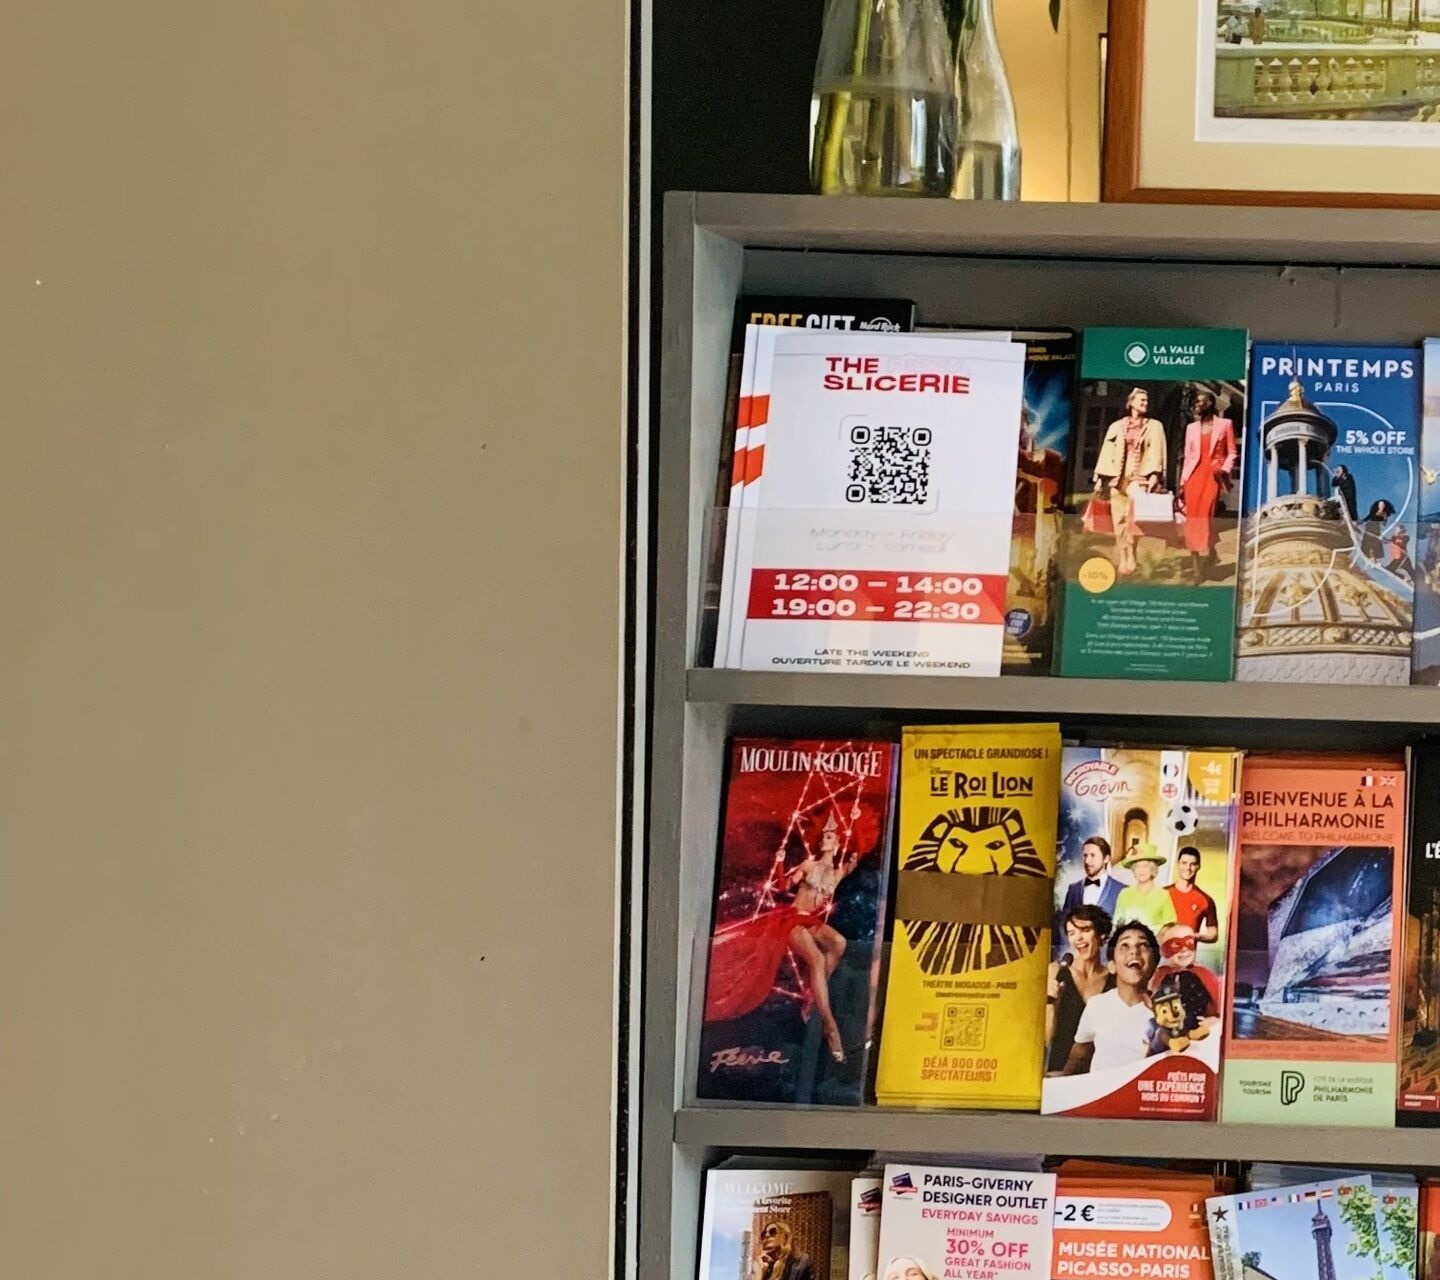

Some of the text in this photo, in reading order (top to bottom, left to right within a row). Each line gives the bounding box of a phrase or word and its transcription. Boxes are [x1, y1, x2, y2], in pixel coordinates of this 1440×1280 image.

[1152, 344, 1205, 355] LA VALLÉE
[825, 357, 880, 374] THE
[1152, 355, 1196, 365] VILLAGE
[1261, 356, 1415, 379] PRINTEMPS
[823, 373, 970, 394] SLICERIE
[1314, 381, 1360, 393] PARIS
[1345, 429, 1406, 446] 5% OFF
[1336, 445, 1415, 456] THE WHOLE STORE
[774, 573, 859, 592] 12:00
[895, 576, 983, 596] 14:00
[771, 598, 857, 617] 19:00
[893, 600, 981, 620] 22:30
[740, 747, 883, 778] MOULIN ROUGE
[930, 774, 949, 793] LE
[1243, 788, 1394, 808] BIENVENUE À LA
[1242, 811, 1385, 829] PHILHARMONIE
[922, 1191, 1048, 1210] DESIGNER OUTLET
[921, 1208, 1039, 1225] EVERYDAY SAVINGS
[946, 1228, 995, 1239] MINIMUM
[945, 1238, 1030, 1258] 30% OFF
[1058, 1240, 1211, 1261] MUSÉE NATIONAL
[944, 1256, 1032, 1271] GREAT FASHION
[1057, 1260, 1191, 1279] PICASSO-PARIS
